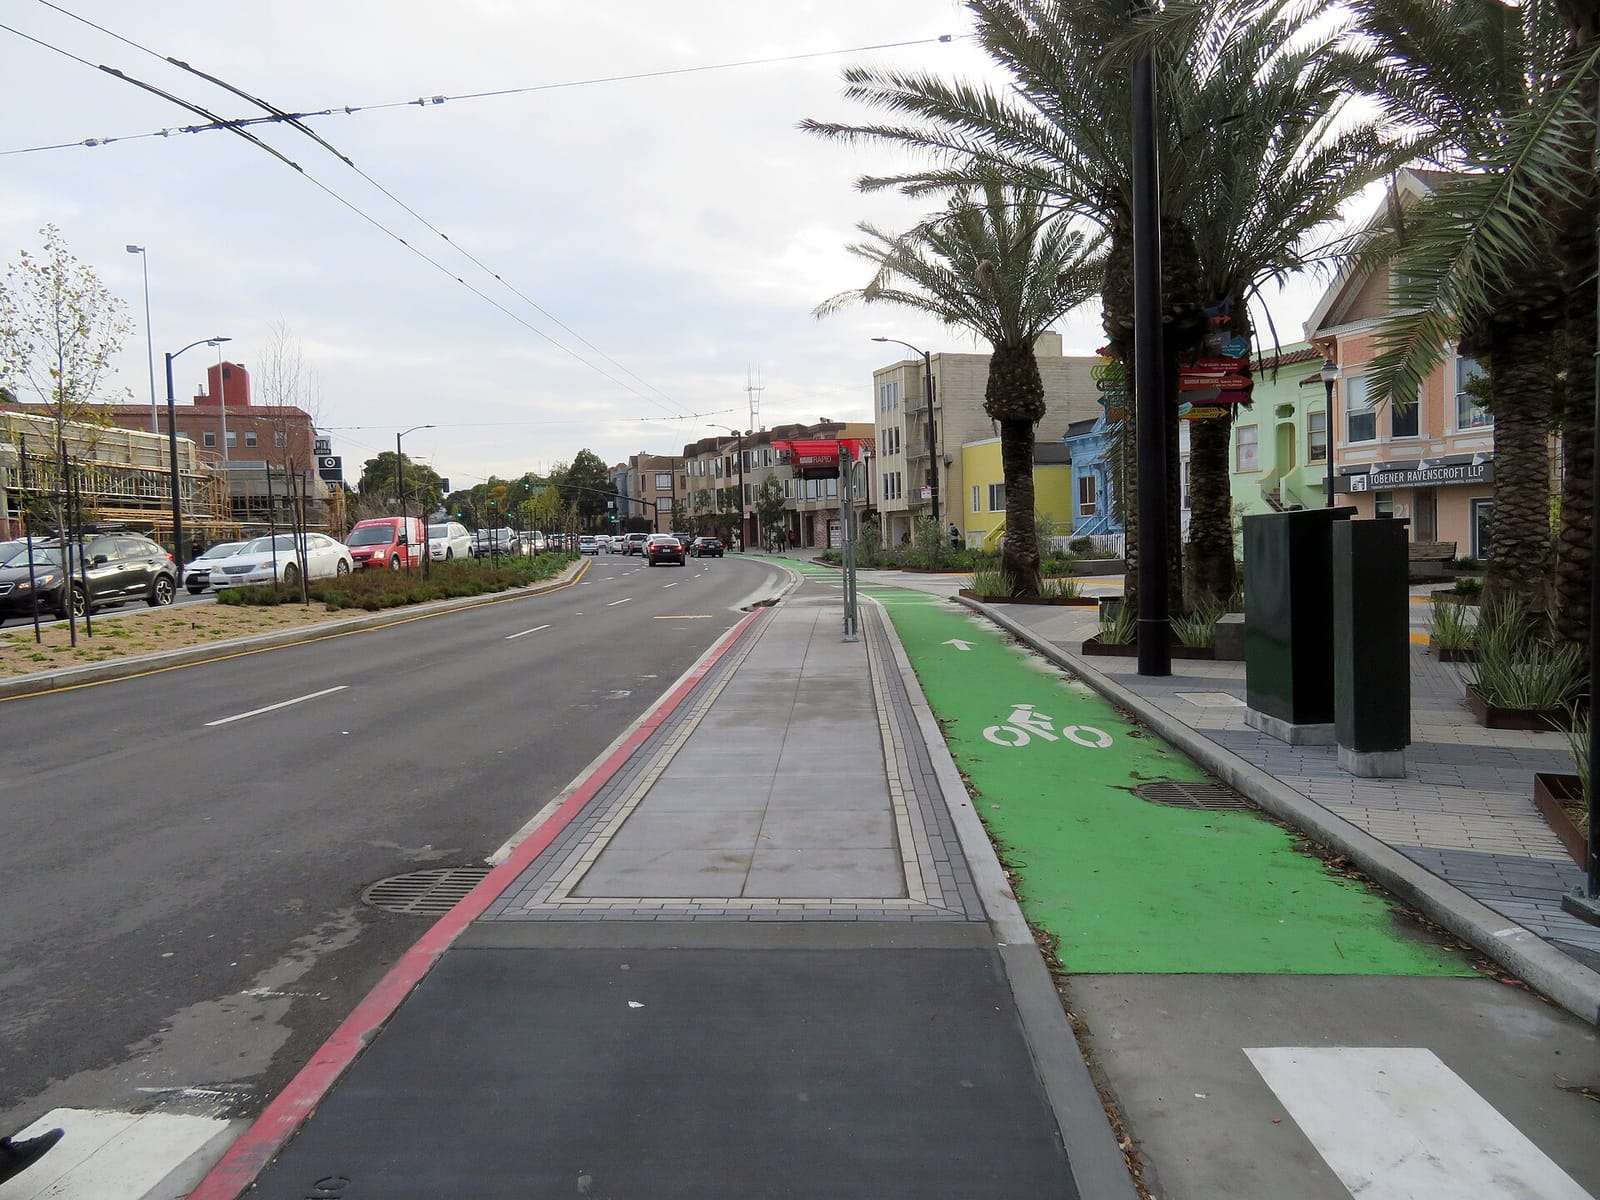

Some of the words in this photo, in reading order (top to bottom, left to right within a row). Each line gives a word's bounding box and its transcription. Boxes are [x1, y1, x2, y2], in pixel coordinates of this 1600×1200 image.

[813, 456, 831, 464] RAPID
[1370, 472, 1404, 484] TOBENER
[1407, 467, 1465, 482] RAVENSCROFT
[1468, 465, 1484, 477] LLP
